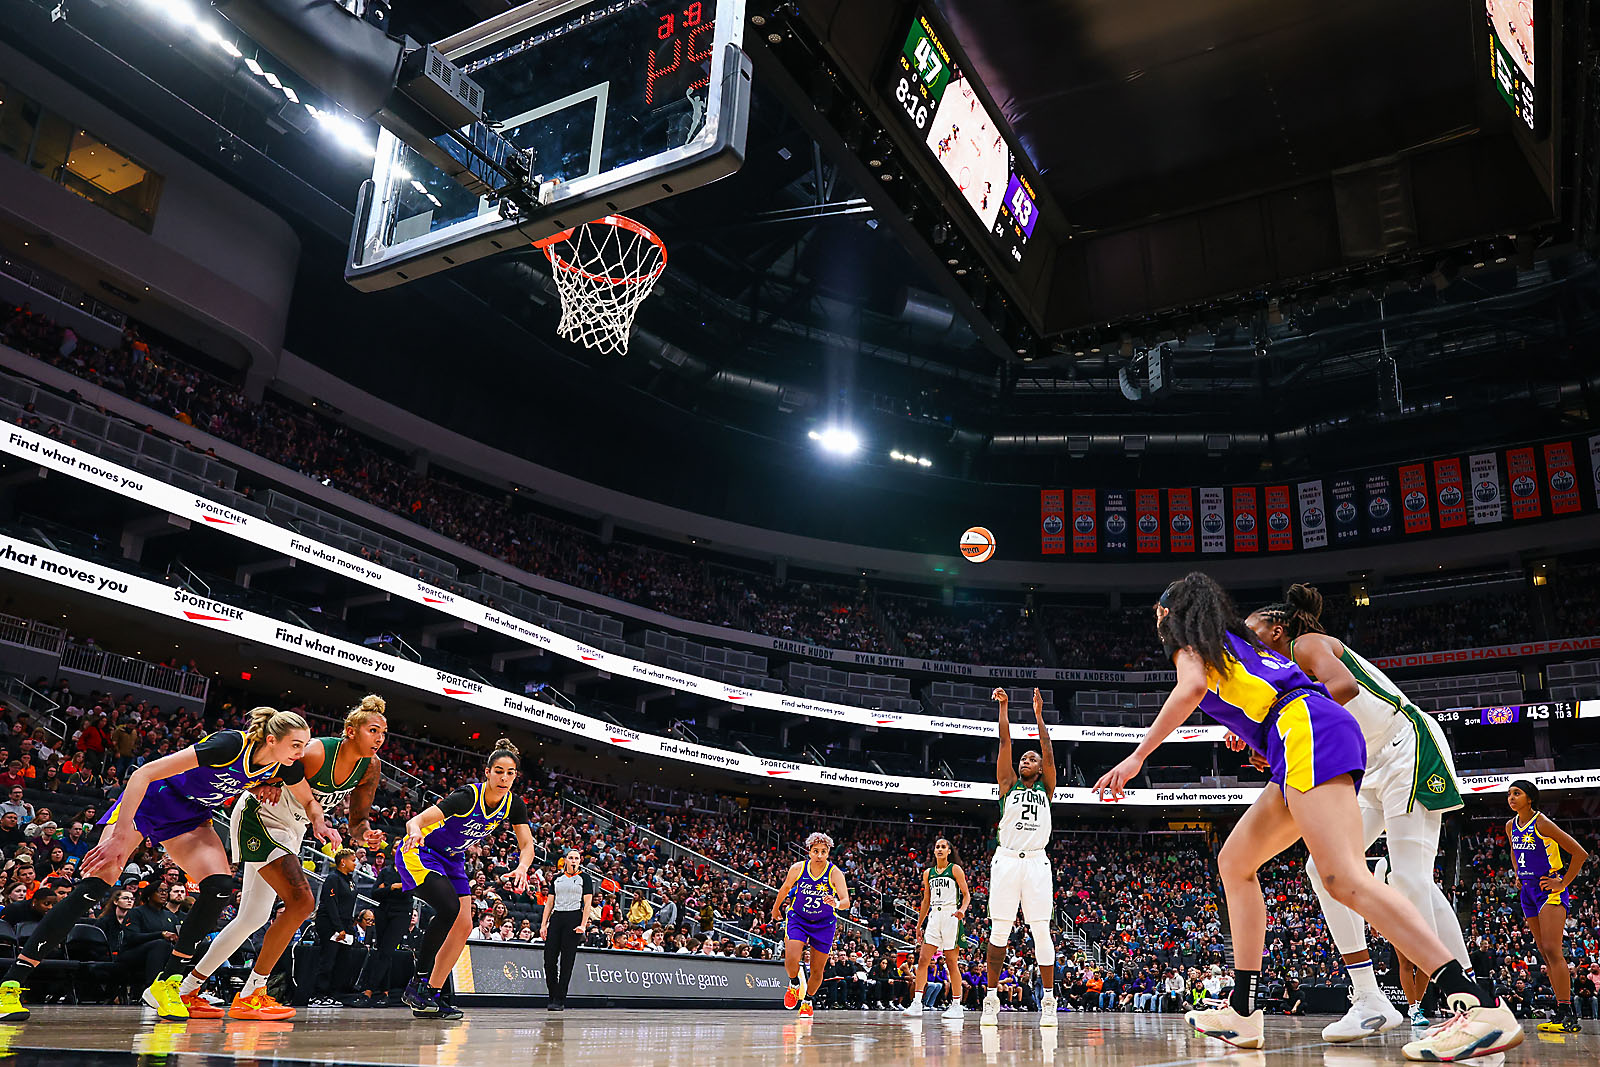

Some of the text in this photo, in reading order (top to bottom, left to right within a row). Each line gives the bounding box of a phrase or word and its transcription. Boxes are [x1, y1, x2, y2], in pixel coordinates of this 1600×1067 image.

[920, 16, 950, 64] SEATTLE STORM
[914, 37, 942, 83] 47
[896, 78, 927, 129] 8:16
[1012, 186, 1032, 227] 43
[9, 433, 143, 490] Find what moves you
[195, 500, 247, 525] SPORTCHEK
[291, 539, 381, 580] Find what moves you
[40, 560, 95, 583] moves
[98, 578, 128, 593] you
[174, 591, 243, 620] SPORTCHEK
[485, 613, 550, 643] Find what moves you
[276, 628, 394, 672] Find what moves you
[773, 640, 834, 659] CHARLIE HUDDY
[1406, 638, 1600, 666] OILERS HALL OF FAME
[855, 654, 904, 667] RYAN SMYTH
[922, 662, 972, 675] AL HAMILTON
[633, 666, 646, 674] Find
[666, 676, 684, 684] moves
[989, 668, 1037, 678] KEVIN LOWE
[1056, 671, 1125, 681] GLENN ANDERSON
[1144, 673, 1160, 681] JARI
[437, 672, 482, 692] SPORTCHEK
[504, 697, 585, 729] Find what moves you
[1438, 712, 1459, 722] 8:16
[1526, 705, 1550, 719] 43
[606, 724, 639, 740] SPORTCHEK
[660, 742, 677, 753] Find
[679, 747, 699, 757] what
[701, 753, 724, 762] moves
[761, 759, 800, 770] SPORTCHEK
[820, 771, 837, 780] Find
[839, 774, 858, 782] what
[933, 780, 971, 788] SPORTCHEK
[1462, 776, 1509, 784] SPORTCHEK
[1535, 776, 1556, 784] Find
[1559, 775, 1584, 783] what
[1012, 791, 1046, 808] STORM
[1021, 804, 1038, 821] 24
[1518, 852, 1526, 867] 4
[936, 888, 941, 898] 4
[804, 897, 821, 908] 25
[521, 966, 541, 979] Sun
[586, 964, 729, 990] Here to grow the game
[756, 978, 780, 988] Sun Life
